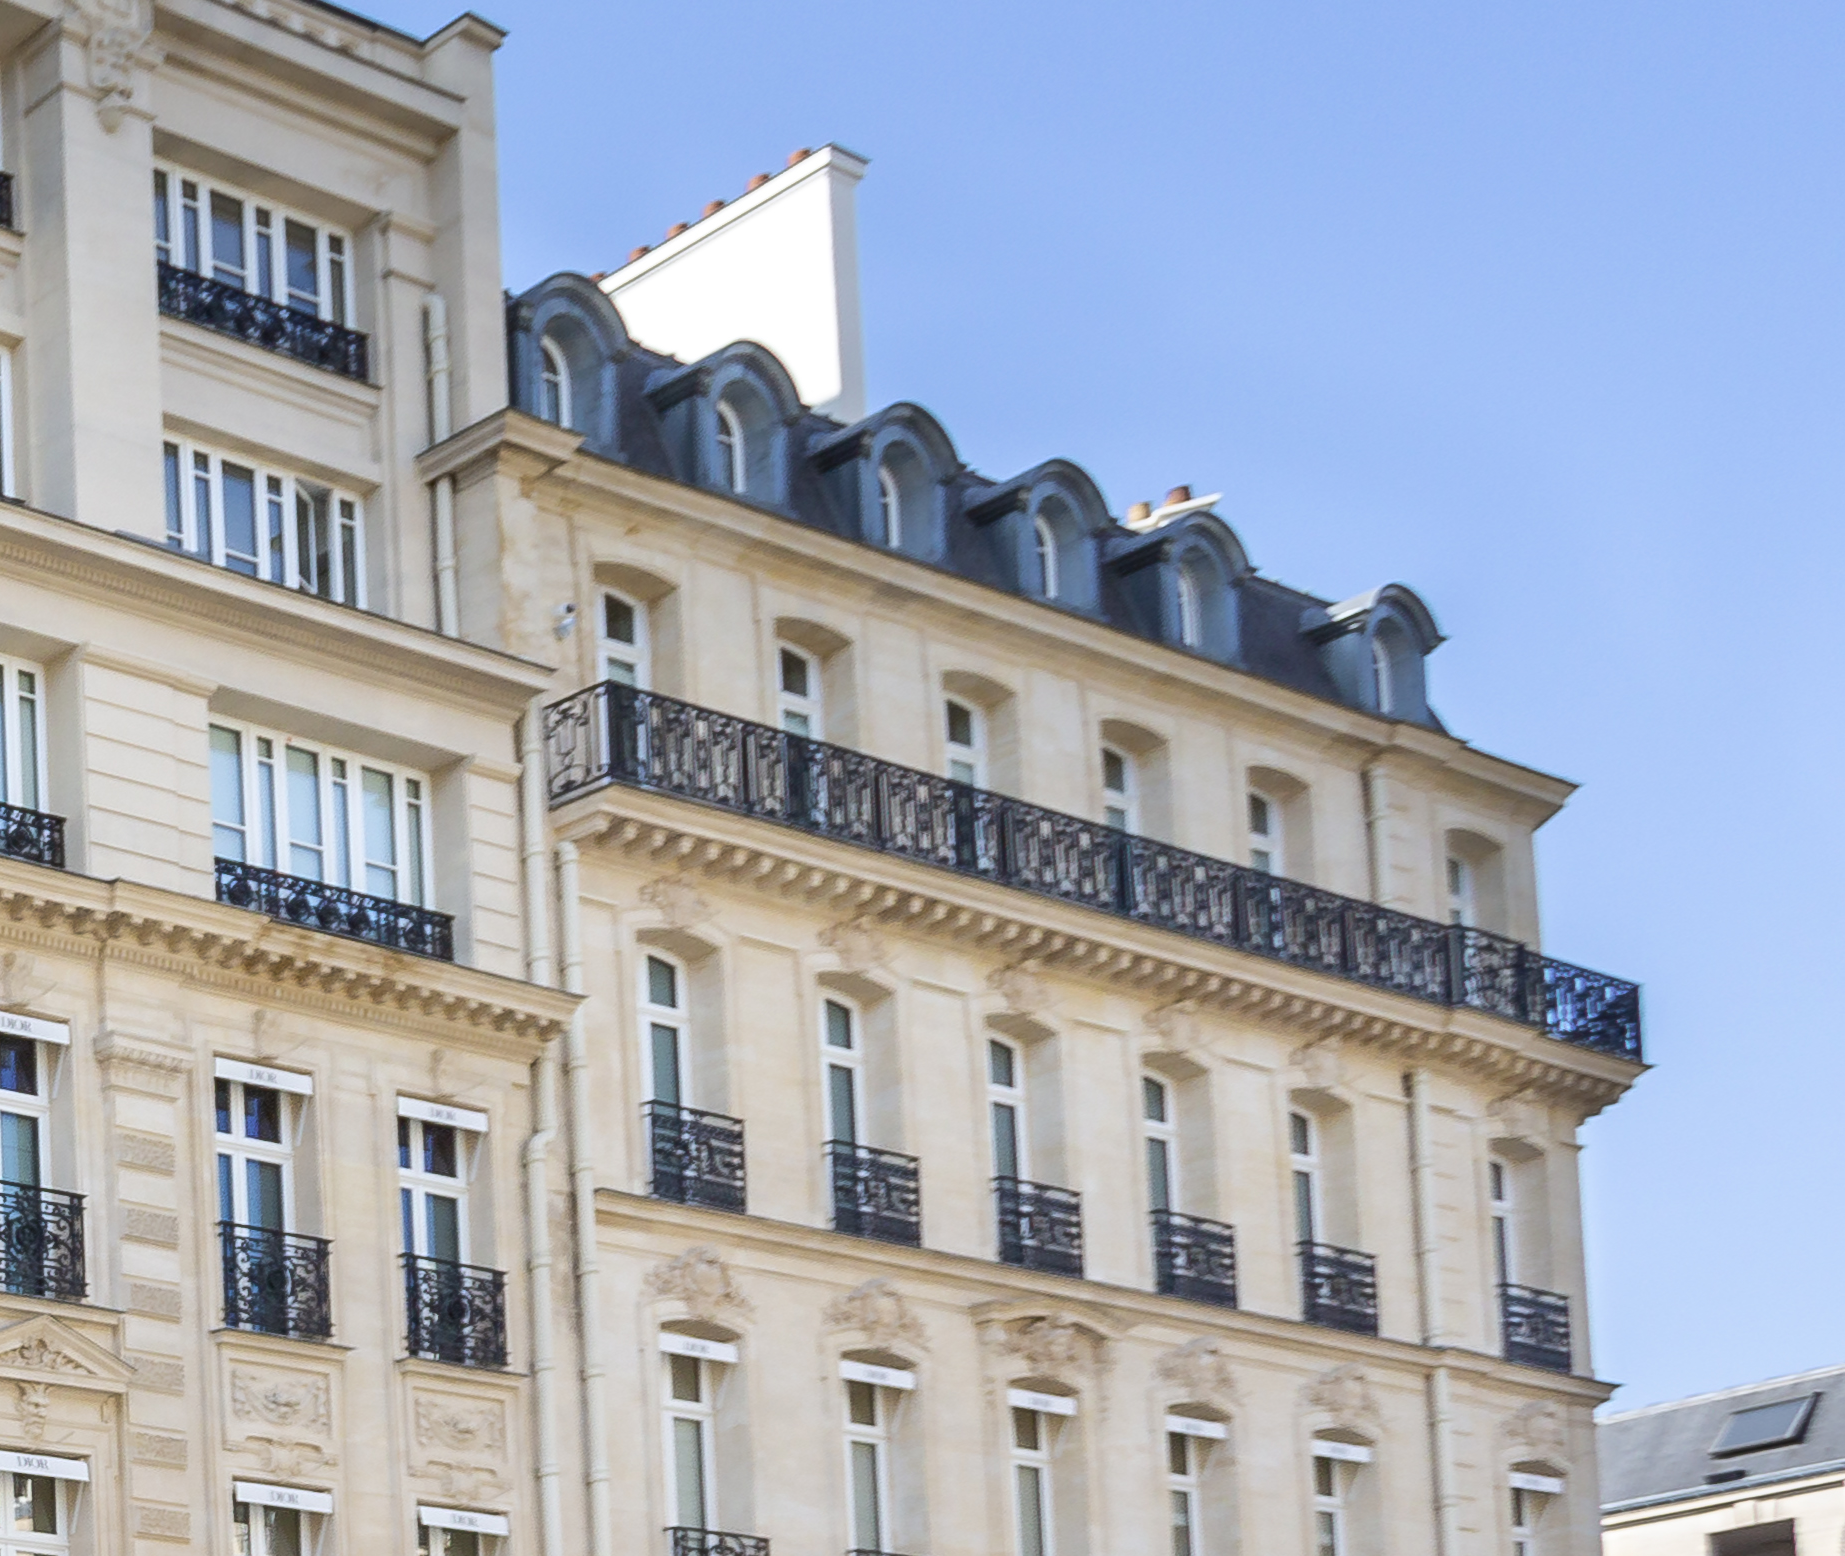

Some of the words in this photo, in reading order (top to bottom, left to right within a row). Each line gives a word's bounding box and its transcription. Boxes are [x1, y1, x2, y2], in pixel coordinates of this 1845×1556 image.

[1, 1016, 32, 1032] DIOR
[248, 1069, 277, 1084] DIOR
[16, 1455, 49, 1471] DIOR
[269, 1489, 299, 1504] DIOR
